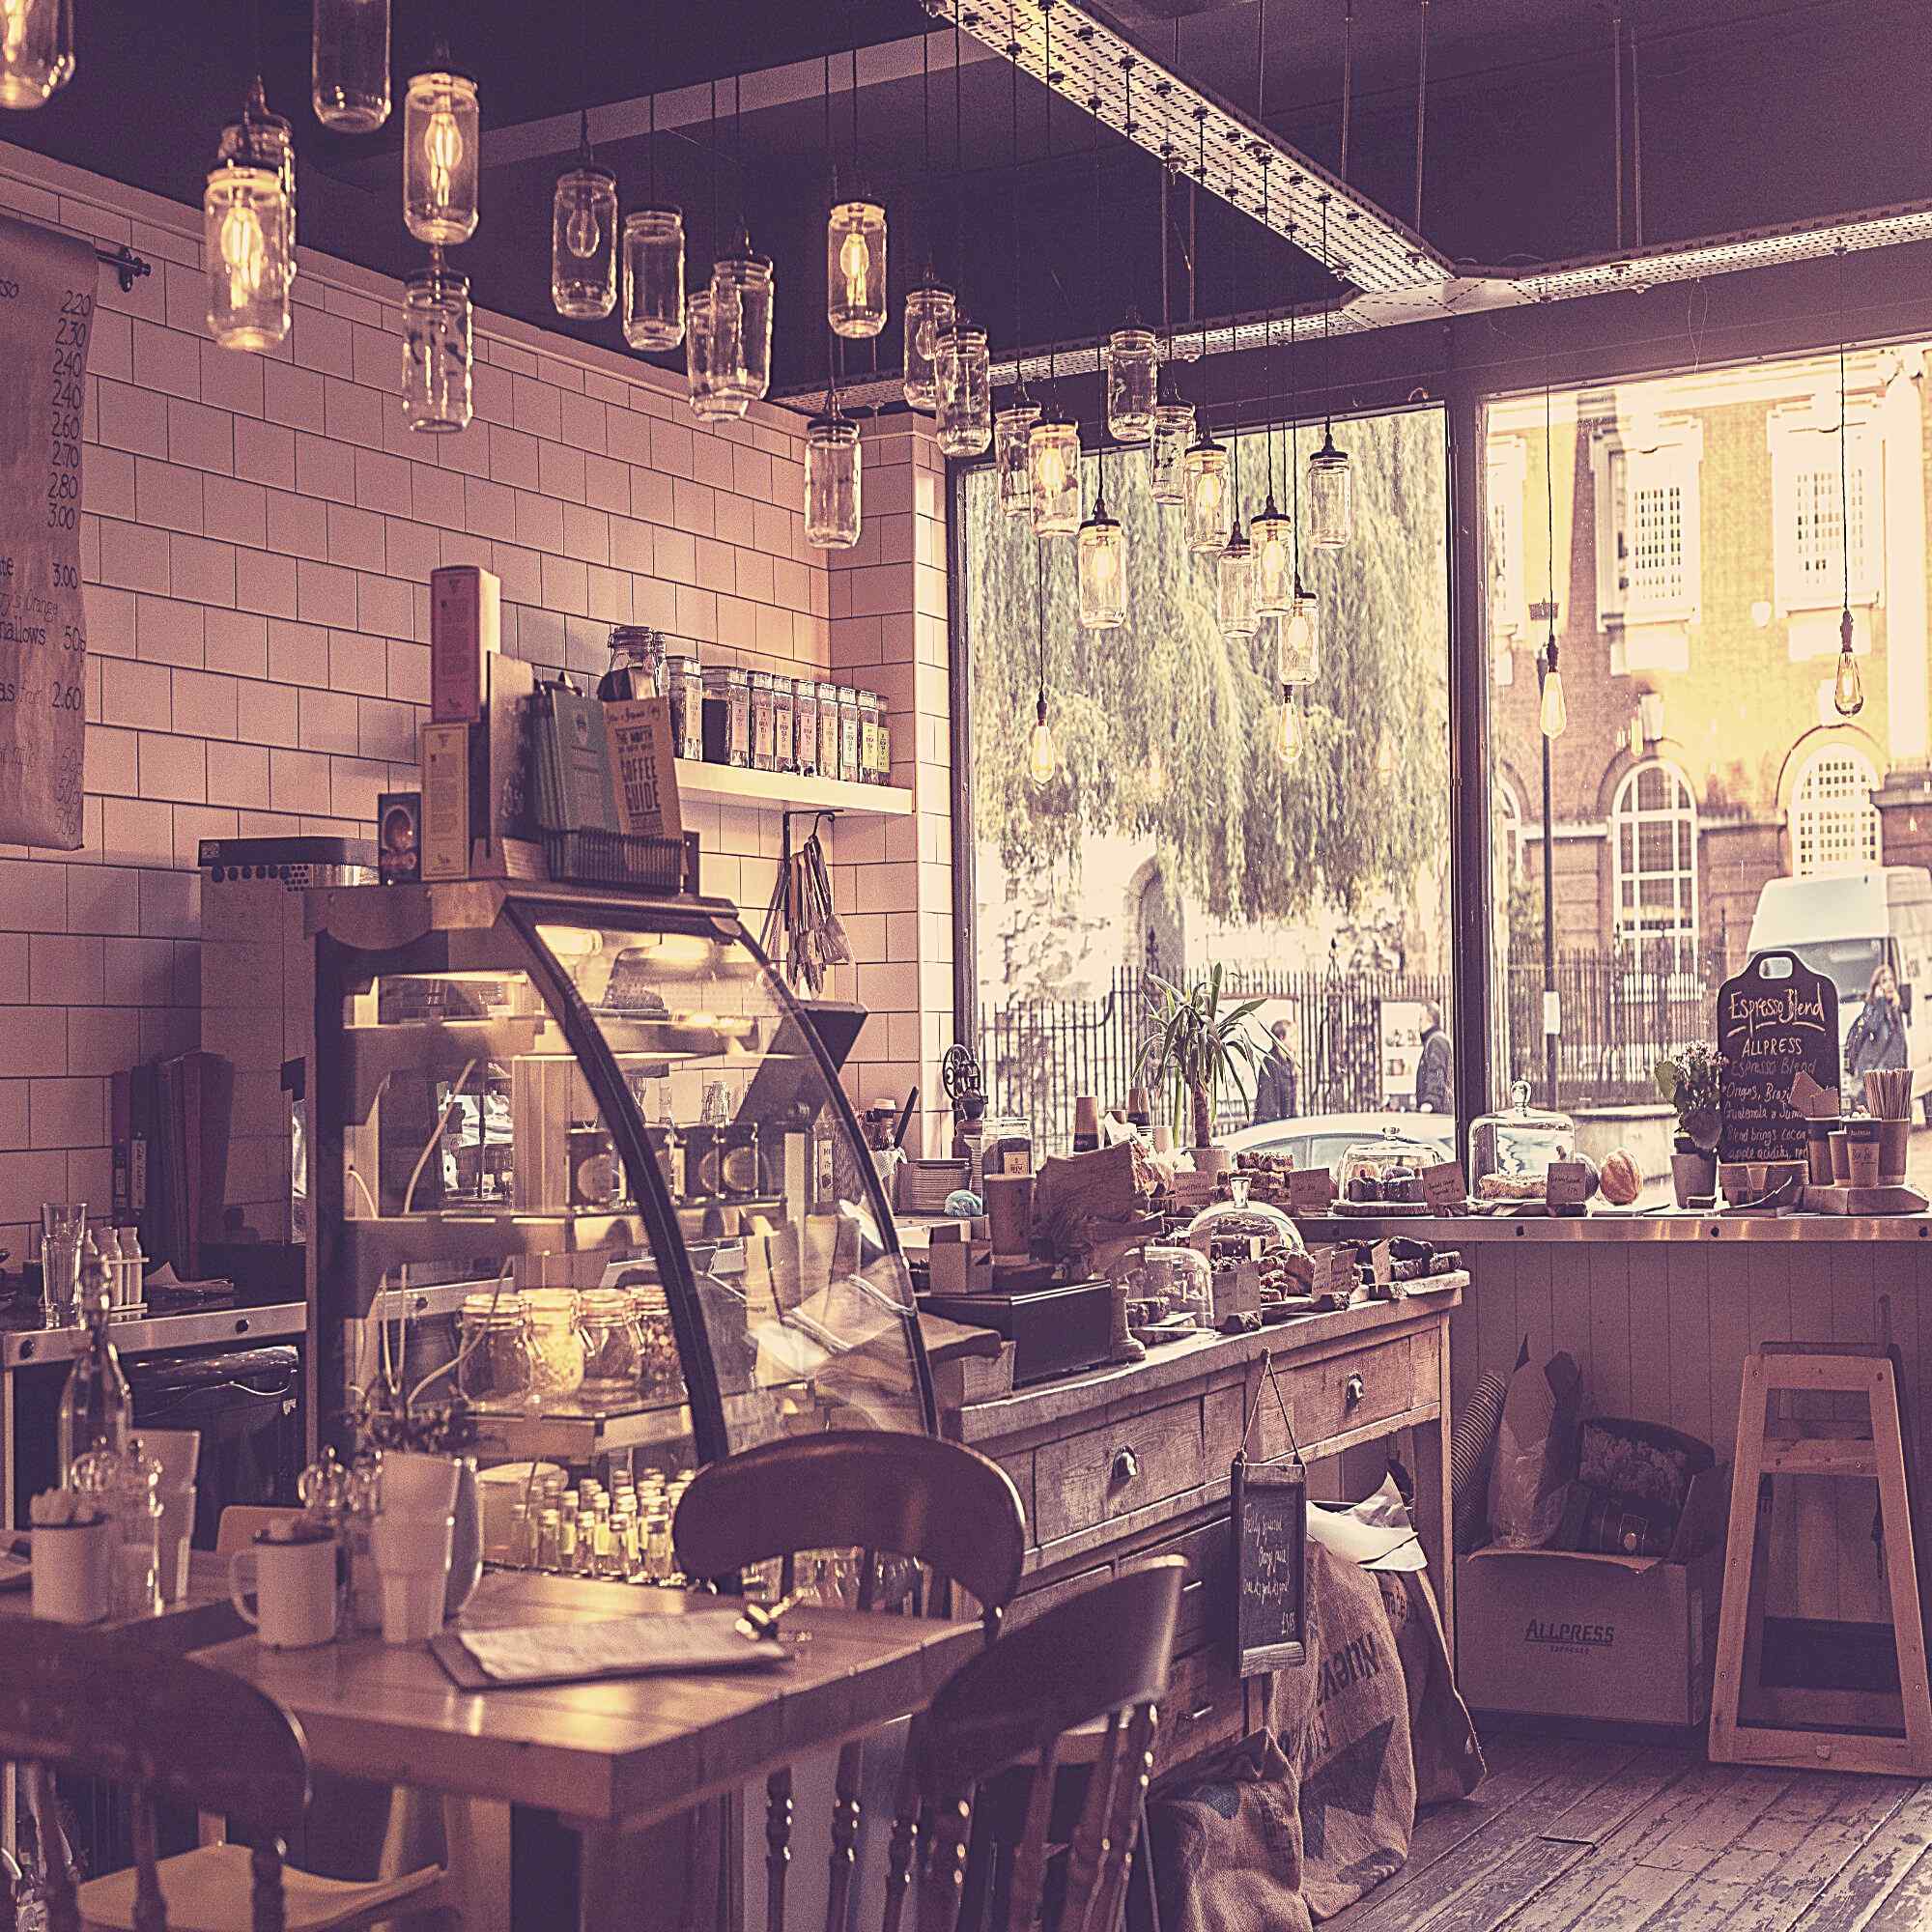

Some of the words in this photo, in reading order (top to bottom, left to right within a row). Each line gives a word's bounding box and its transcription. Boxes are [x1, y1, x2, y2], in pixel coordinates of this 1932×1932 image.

[52, 561, 78, 590] 3.00
[52, 681, 82, 711] 2.60
[620, 755, 658, 783] COFFEE
[624, 780, 662, 811] GUIDE
[1728, 991, 1784, 1038] Espresso
[1779, 982, 1825, 1023] Blend
[1742, 1037, 1803, 1058] ALLPRESS
[1525, 1619, 1615, 1644] ALLPRESS
